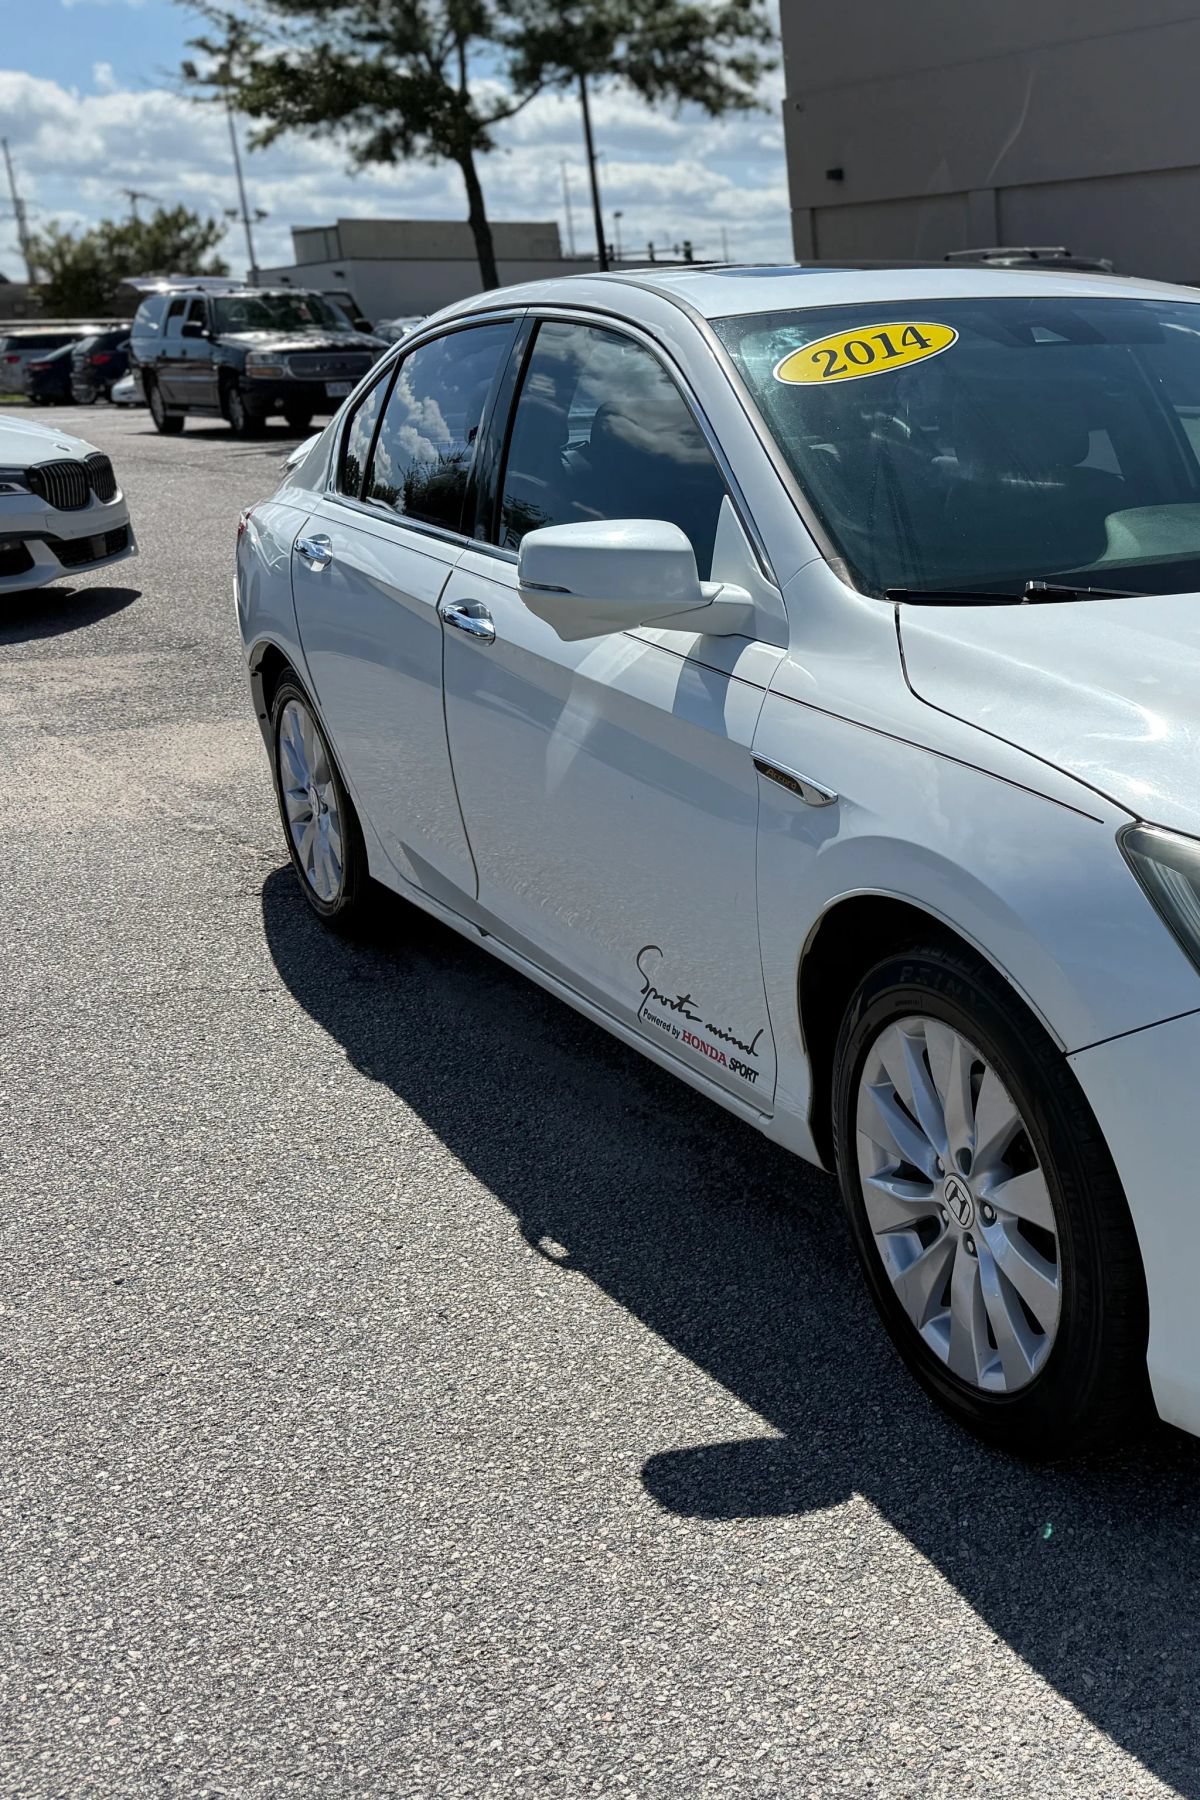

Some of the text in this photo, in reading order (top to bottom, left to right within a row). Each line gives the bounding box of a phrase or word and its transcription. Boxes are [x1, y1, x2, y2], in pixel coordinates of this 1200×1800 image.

[811, 326, 932, 378] 2014
[766, 768, 797, 790] Accord
[643, 1007, 760, 1084] Powered by HONDA SPORT
